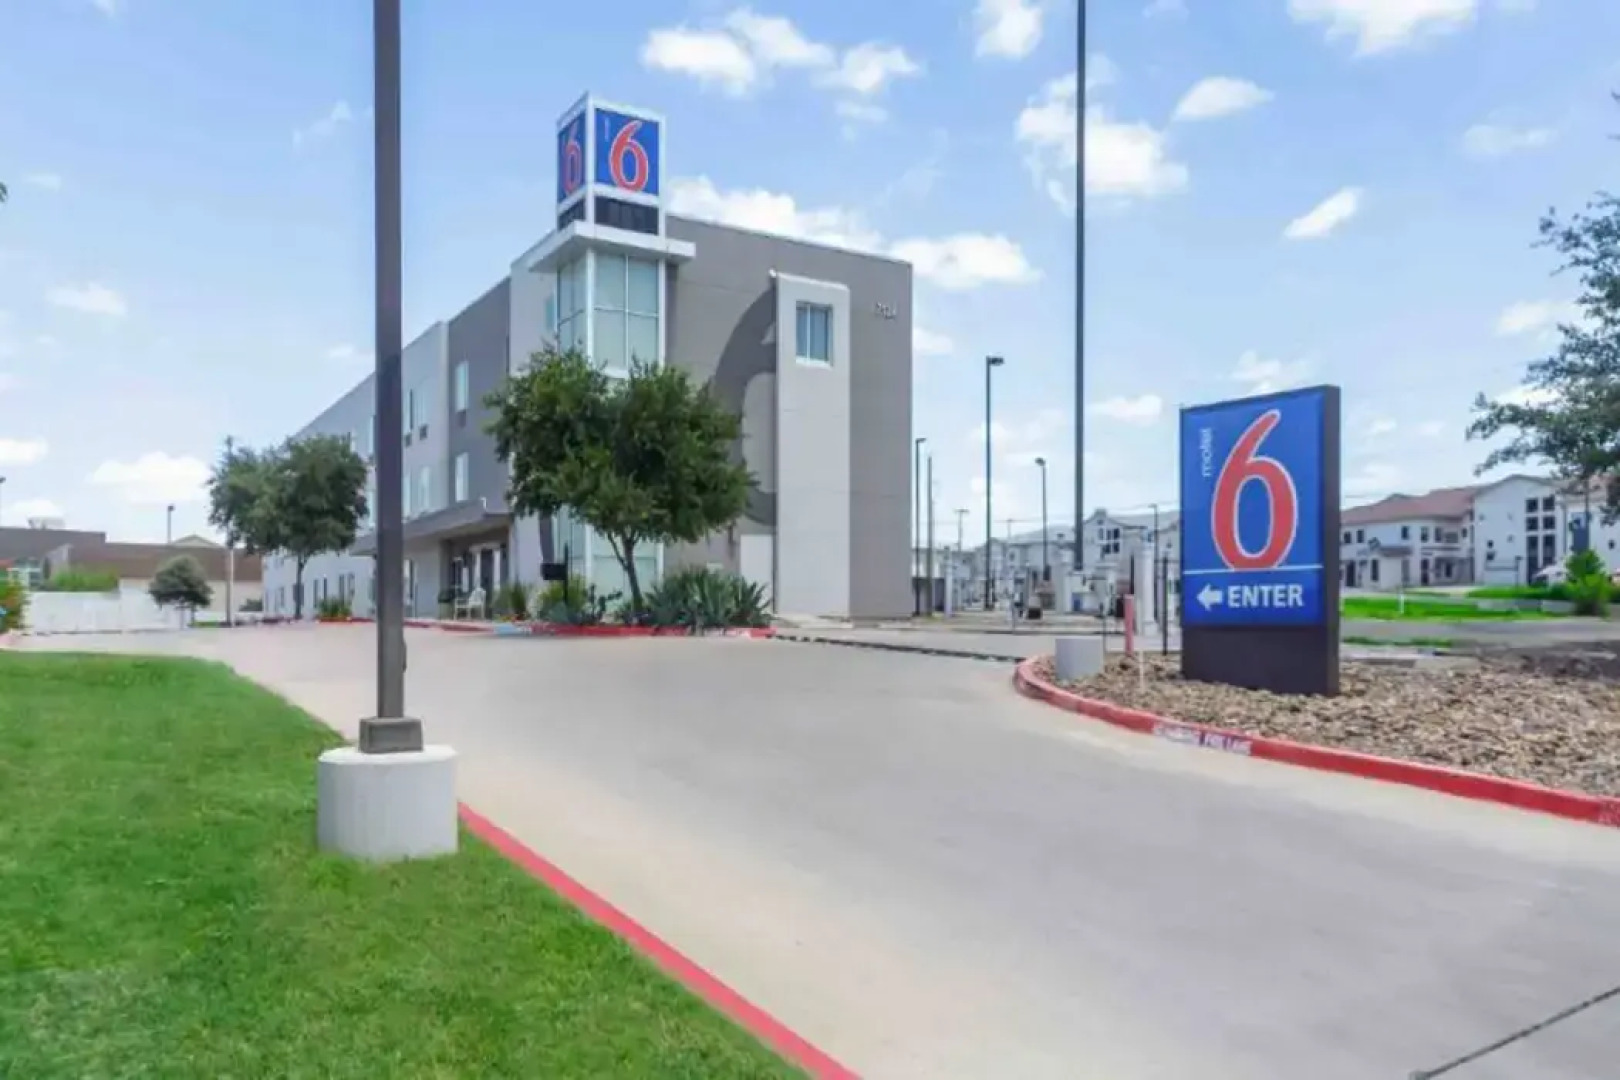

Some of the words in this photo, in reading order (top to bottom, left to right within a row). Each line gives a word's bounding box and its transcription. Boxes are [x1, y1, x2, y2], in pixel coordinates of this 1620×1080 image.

[563, 120, 582, 196] 6
[609, 119, 649, 194] 6
[1211, 409, 1298, 572] 6
[1227, 584, 1304, 608] ENTER
